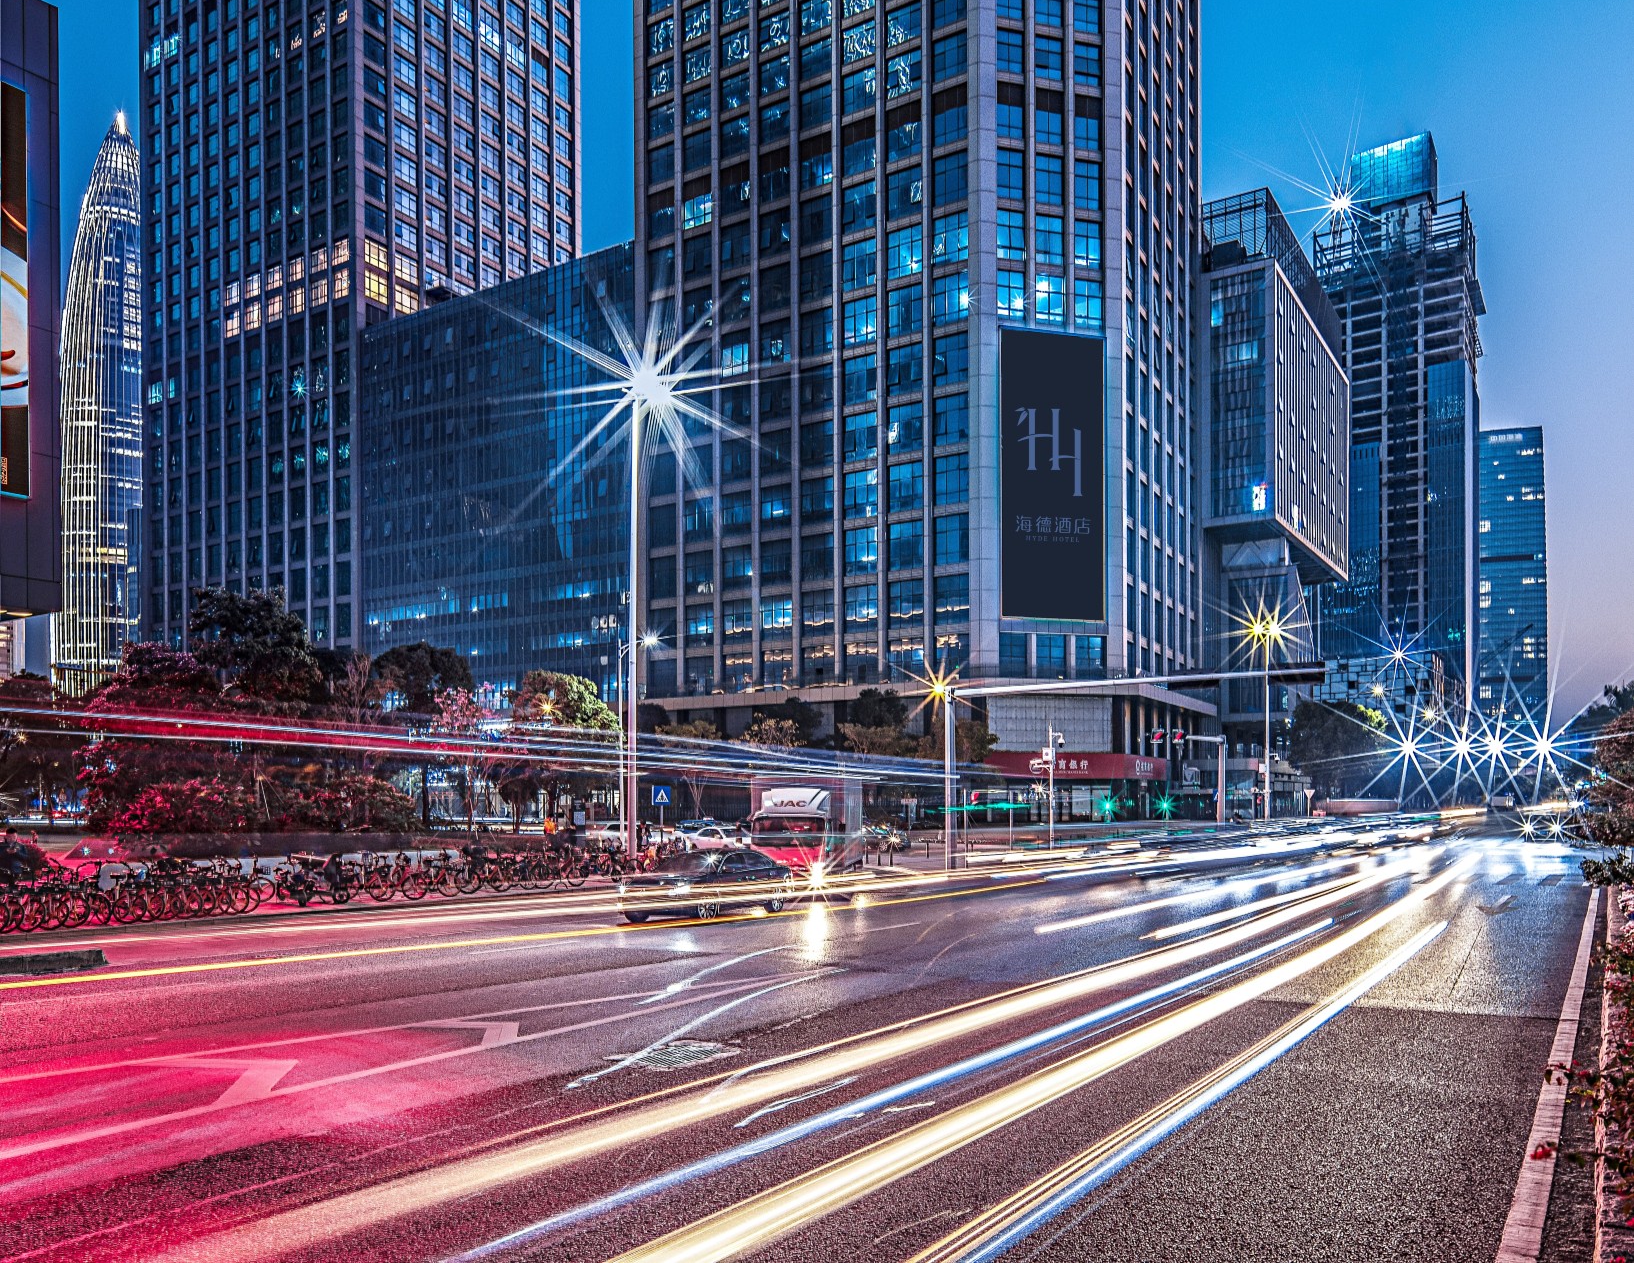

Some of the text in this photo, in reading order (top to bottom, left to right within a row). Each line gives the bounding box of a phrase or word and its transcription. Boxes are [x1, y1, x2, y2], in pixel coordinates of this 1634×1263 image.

[1016, 515, 1091, 534] 海德酒店
[1052, 535, 1080, 543] HOTEL
[1053, 758, 1089, 770] 商银行
